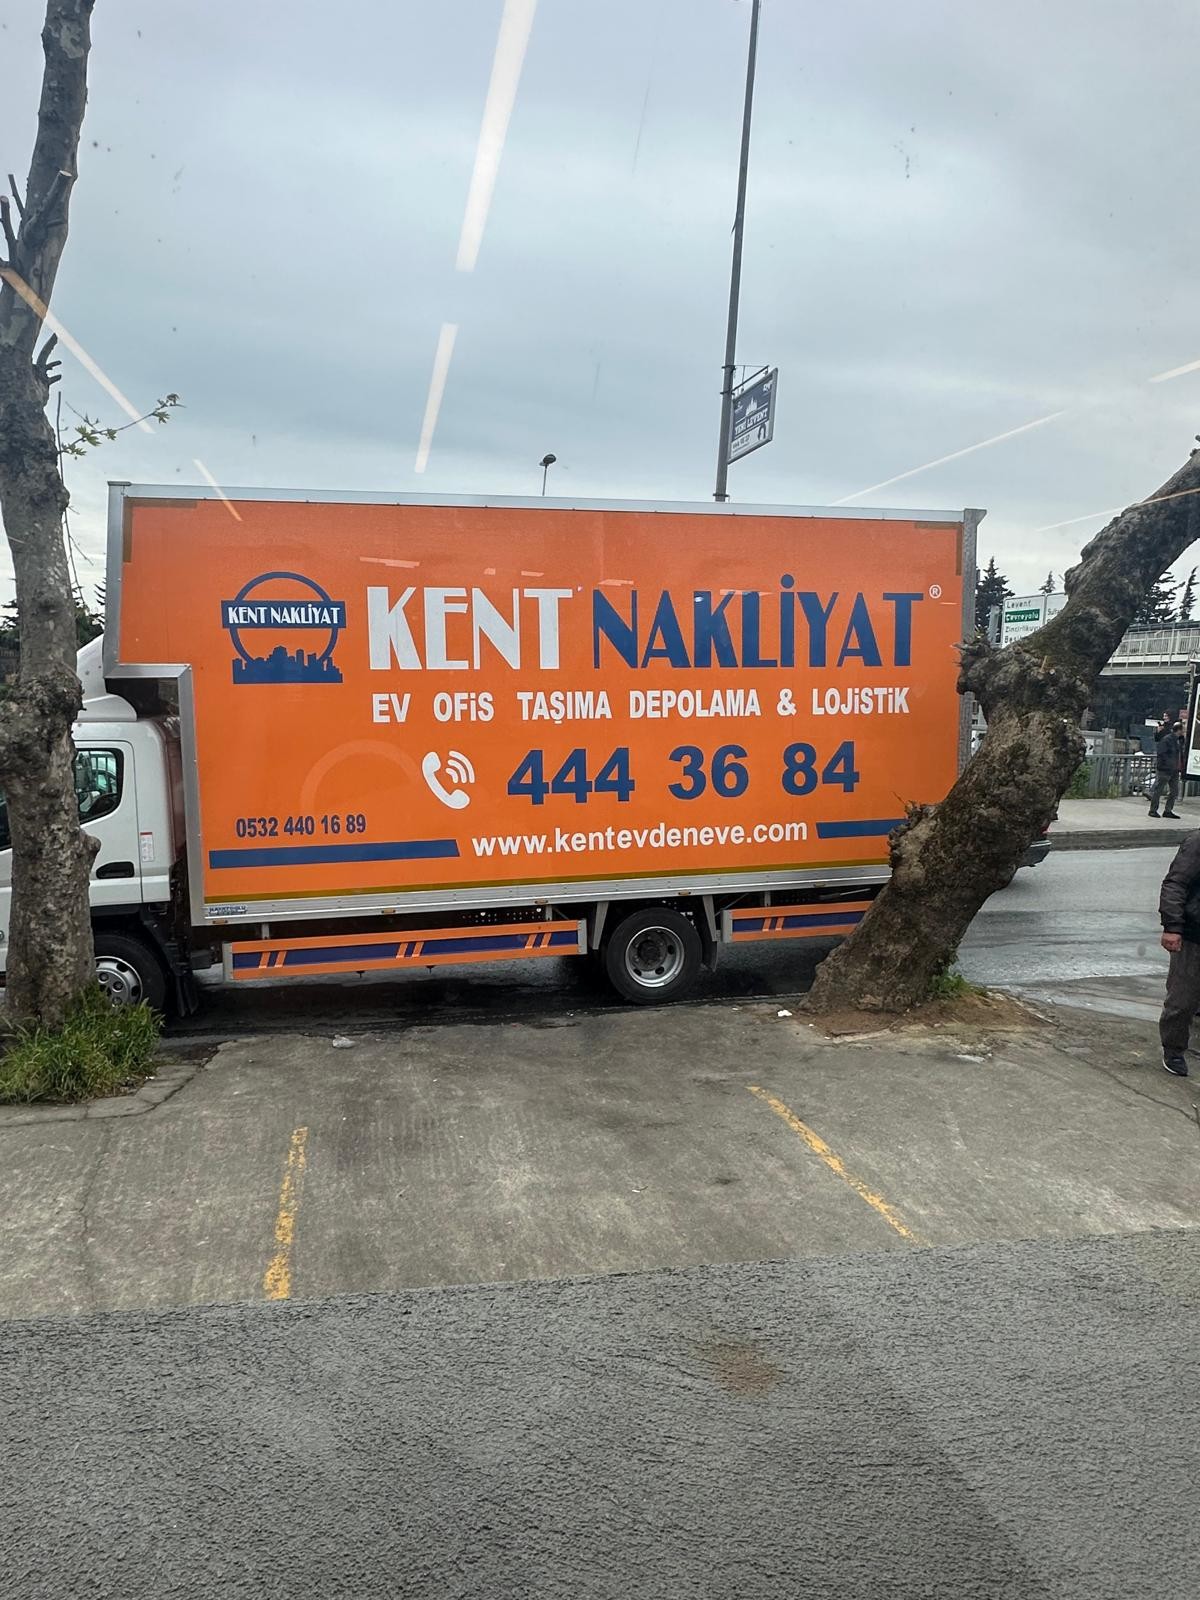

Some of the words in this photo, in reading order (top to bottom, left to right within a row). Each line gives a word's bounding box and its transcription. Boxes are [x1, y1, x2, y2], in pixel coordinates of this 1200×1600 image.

[228, 606, 267, 624] KENT
[271, 603, 340, 624] NAKLİYAT
[367, 586, 573, 670] KENT
[592, 574, 924, 669] NAKLİYAT
[1006, 601, 1031, 609] Levent
[372, 693, 411, 723] EV
[517, 690, 612, 724] TAŞIMA
[629, 688, 762, 719] DEPOLAMA
[776, 688, 797, 716] &
[507, 747, 636, 806] 444
[668, 744, 750, 800] 36
[781, 741, 860, 796] 84
[236, 816, 279, 838] 0532
[284, 815, 315, 836] 440
[321, 814, 341, 834] 16
[346, 813, 366, 834] 89
[471, 822, 808, 857] www.kentevdeneve.com
